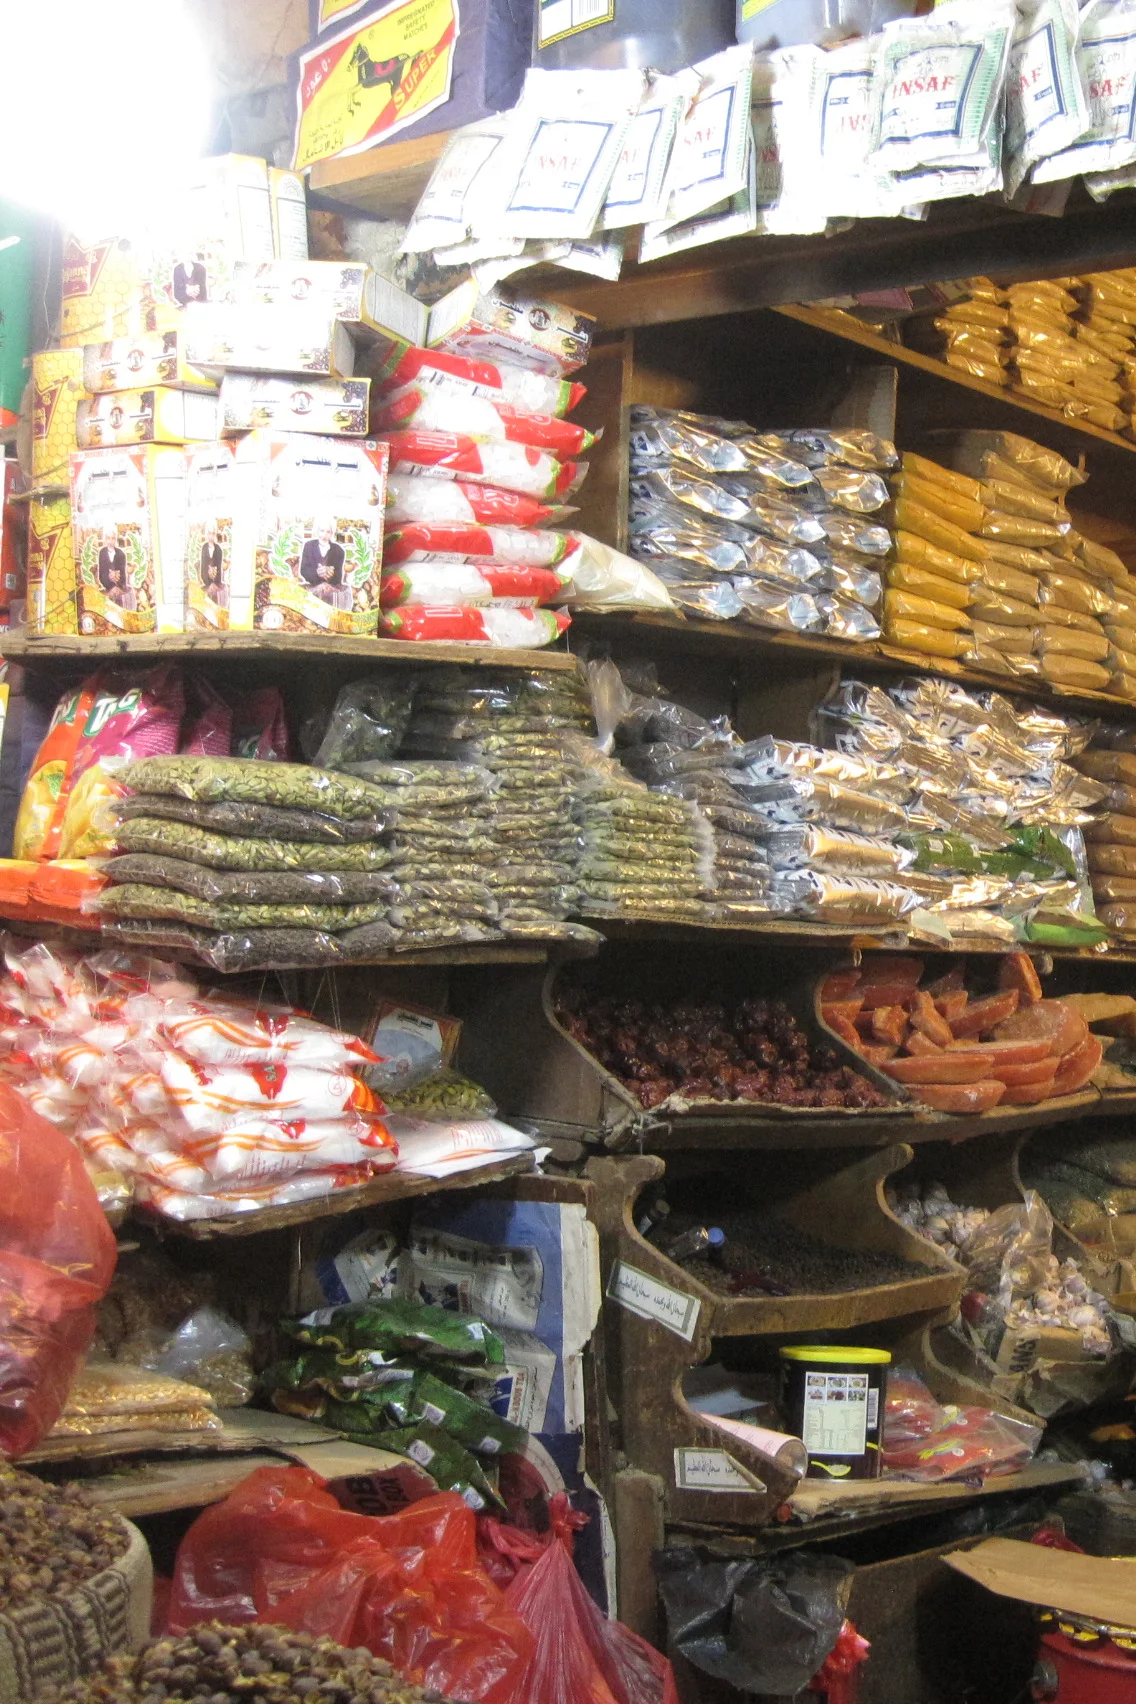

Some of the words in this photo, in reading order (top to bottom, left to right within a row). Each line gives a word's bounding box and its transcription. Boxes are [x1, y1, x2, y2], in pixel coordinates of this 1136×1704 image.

[403, 22, 429, 41] MATCHES
[405, 13, 426, 31] SAFETY
[394, 50, 437, 109] SUPER
[892, 75, 957, 100] INSAF
